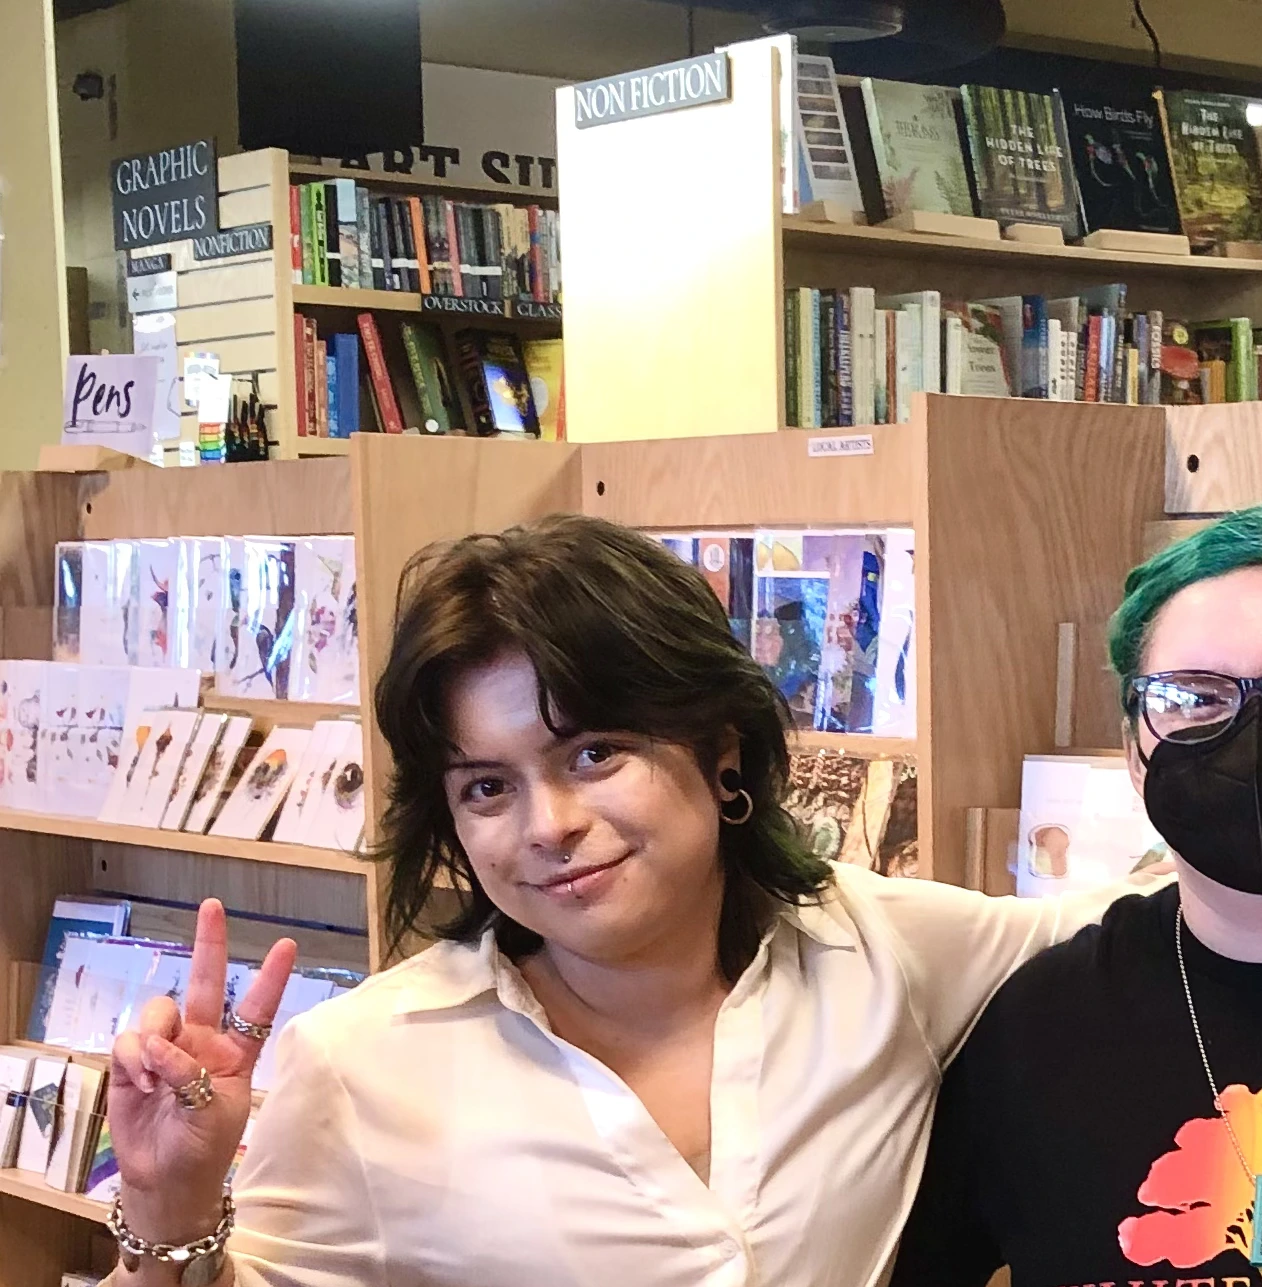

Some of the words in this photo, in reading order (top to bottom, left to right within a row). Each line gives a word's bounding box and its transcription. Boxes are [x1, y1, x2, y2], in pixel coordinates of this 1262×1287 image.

[576, 80, 625, 121] NON
[630, 59, 721, 110] FICTION
[1073, 104, 1102, 118] How
[1103, 106, 1135, 123] Birds
[1136, 109, 1154, 129] Fly
[1010, 124, 1034, 138] THE
[985, 137, 1033, 153] HIDDEN
[116, 141, 208, 195] GRAPHIC
[997, 154, 1015, 166] OF
[1020, 157, 1057, 172] TREES
[122, 195, 207, 242] NOVELS
[195, 227, 269, 259] NONFICTION
[130, 256, 166, 274] MANGA
[424, 294, 504, 315] OVERSTOCK
[71, 363, 135, 427] Pens
